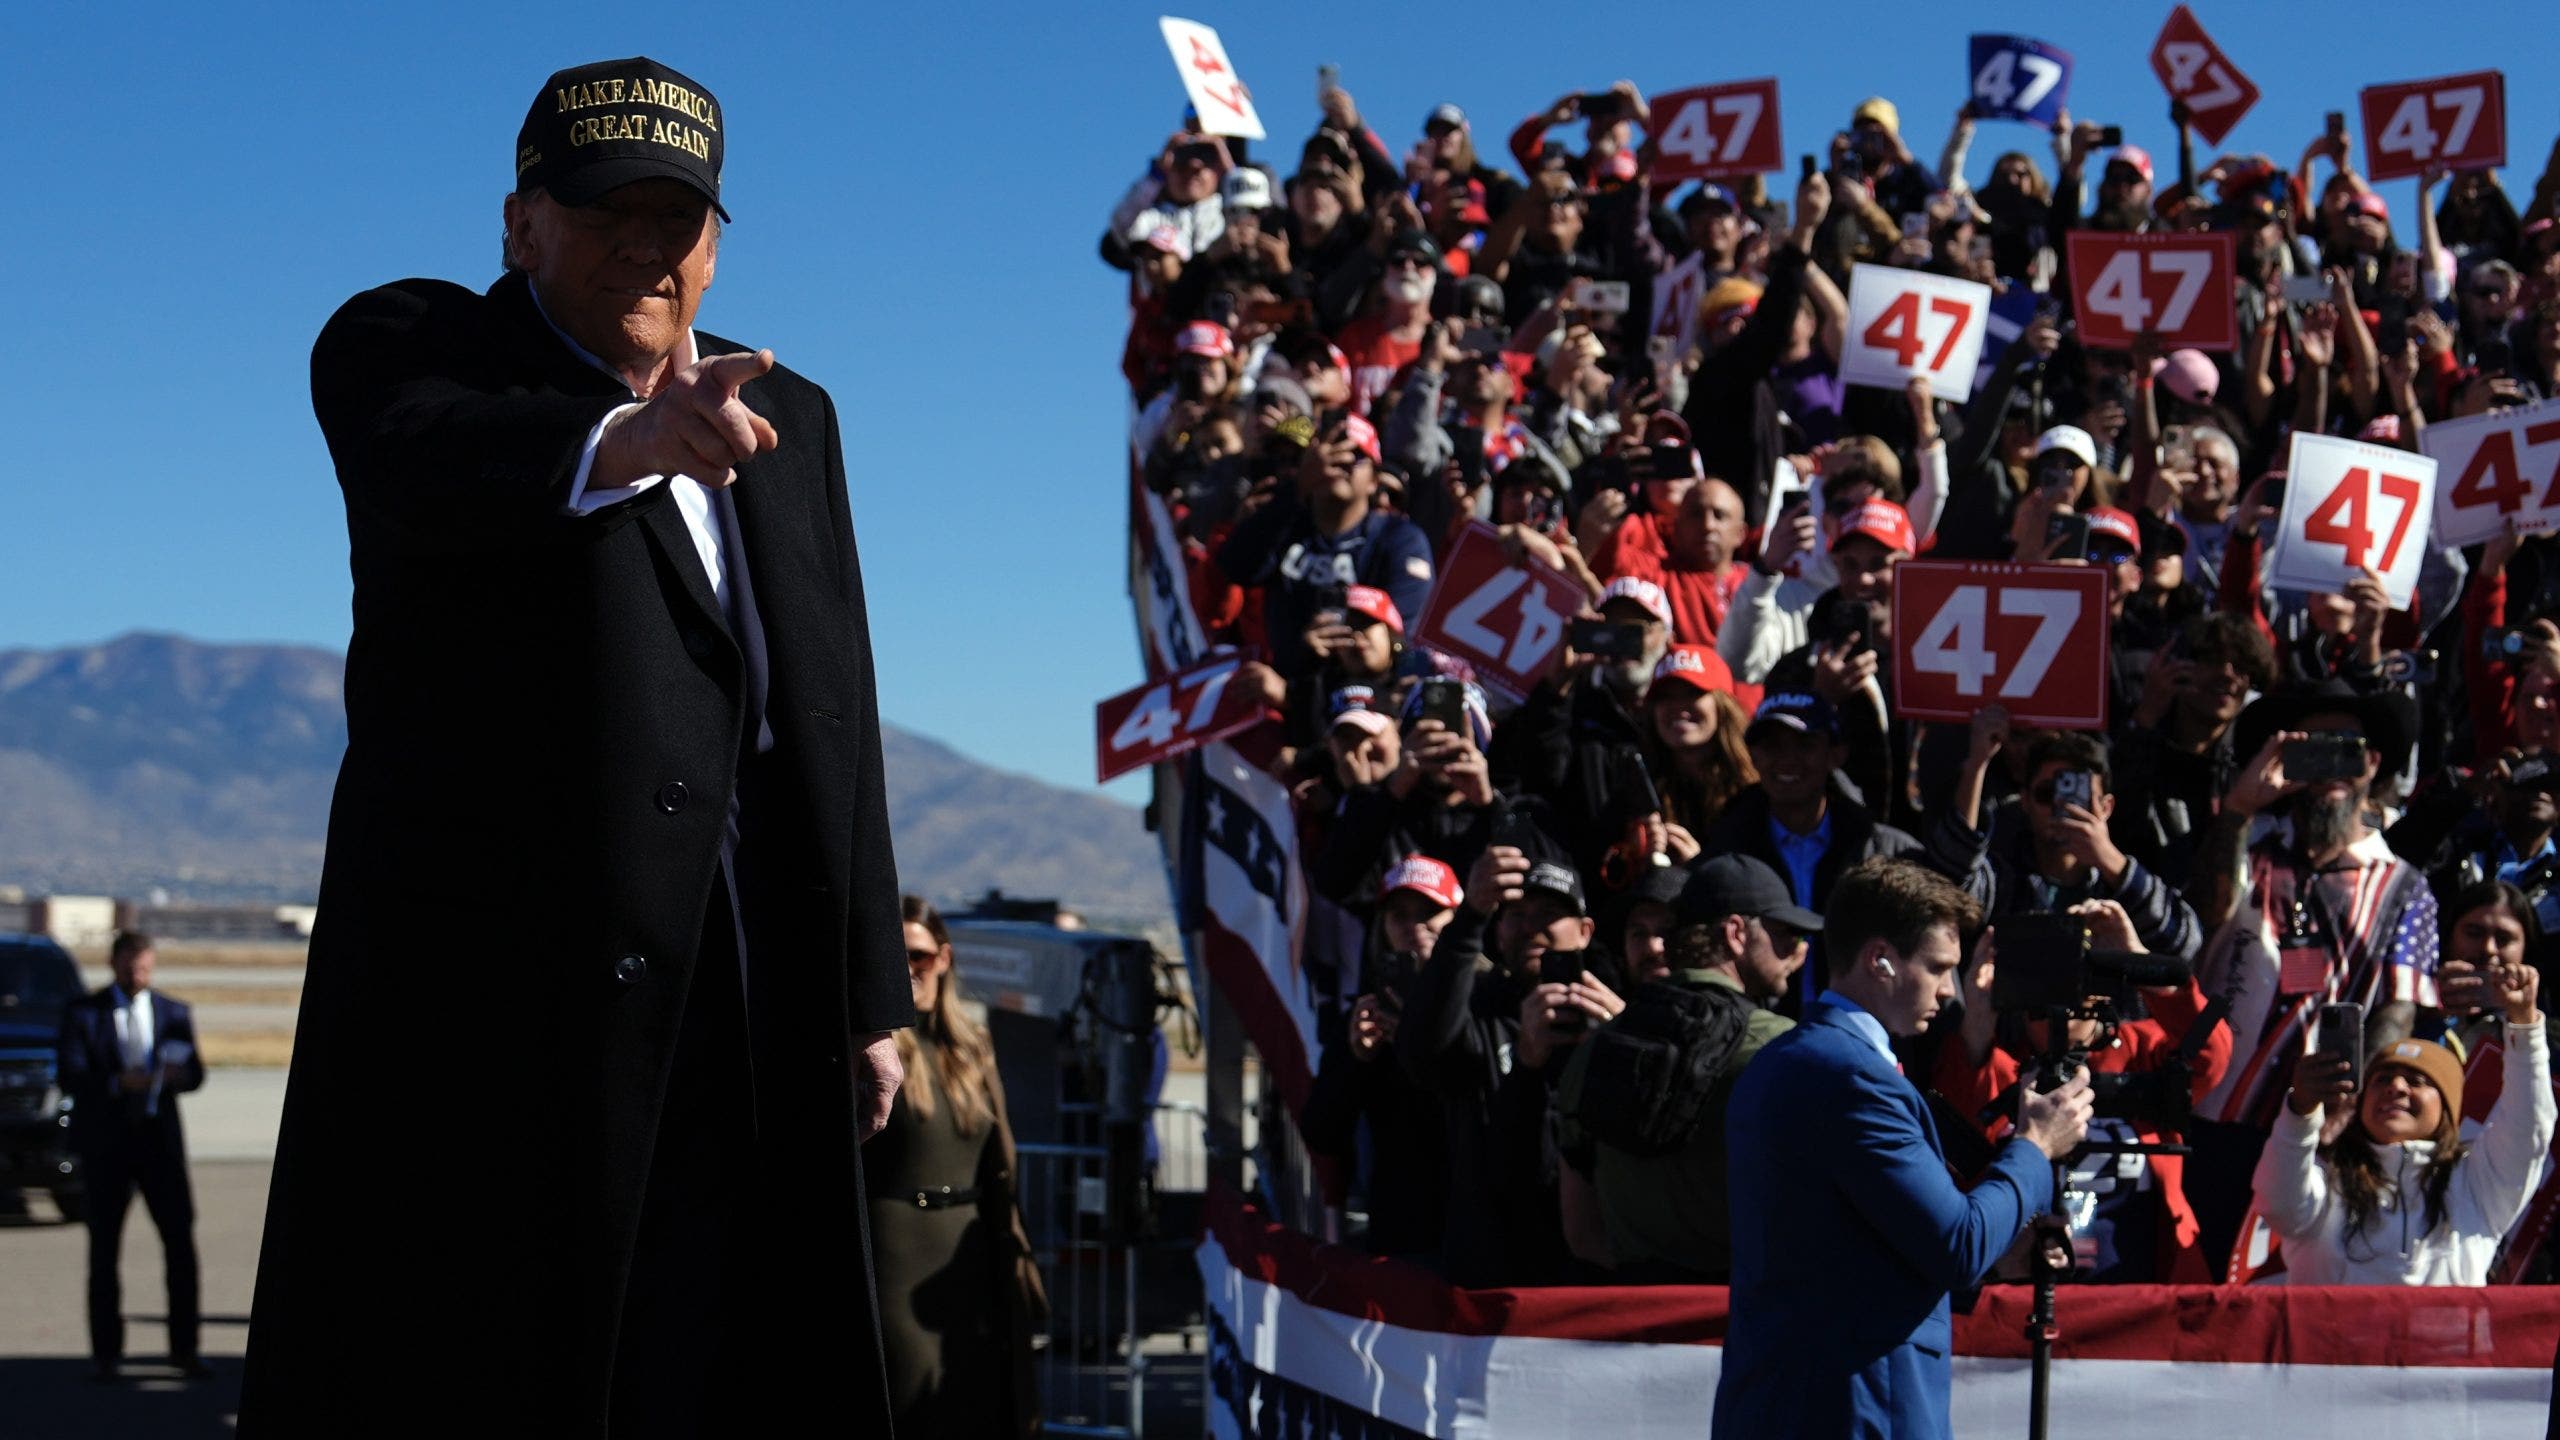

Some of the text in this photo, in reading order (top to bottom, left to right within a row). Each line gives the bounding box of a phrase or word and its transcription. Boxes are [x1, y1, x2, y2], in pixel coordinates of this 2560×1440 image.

[557, 78, 717, 132] MAKE AMERICA
[1188, 35, 1246, 118] 47
[1975, 49, 2063, 113] 47
[2162, 41, 2243, 113] 47
[570, 114, 710, 162] GREAT AGAIN
[1658, 93, 1764, 166] 47
[2379, 85, 2485, 161] 47
[1863, 291, 1973, 373] 47
[2086, 250, 2213, 332] 47
[2449, 420, 2560, 514] 47
[2303, 465, 2421, 573] 47
[1279, 542, 1357, 585] USA
[1441, 566, 1565, 677] 47
[1911, 584, 2083, 699] 47
[1111, 659, 1242, 752] 47
